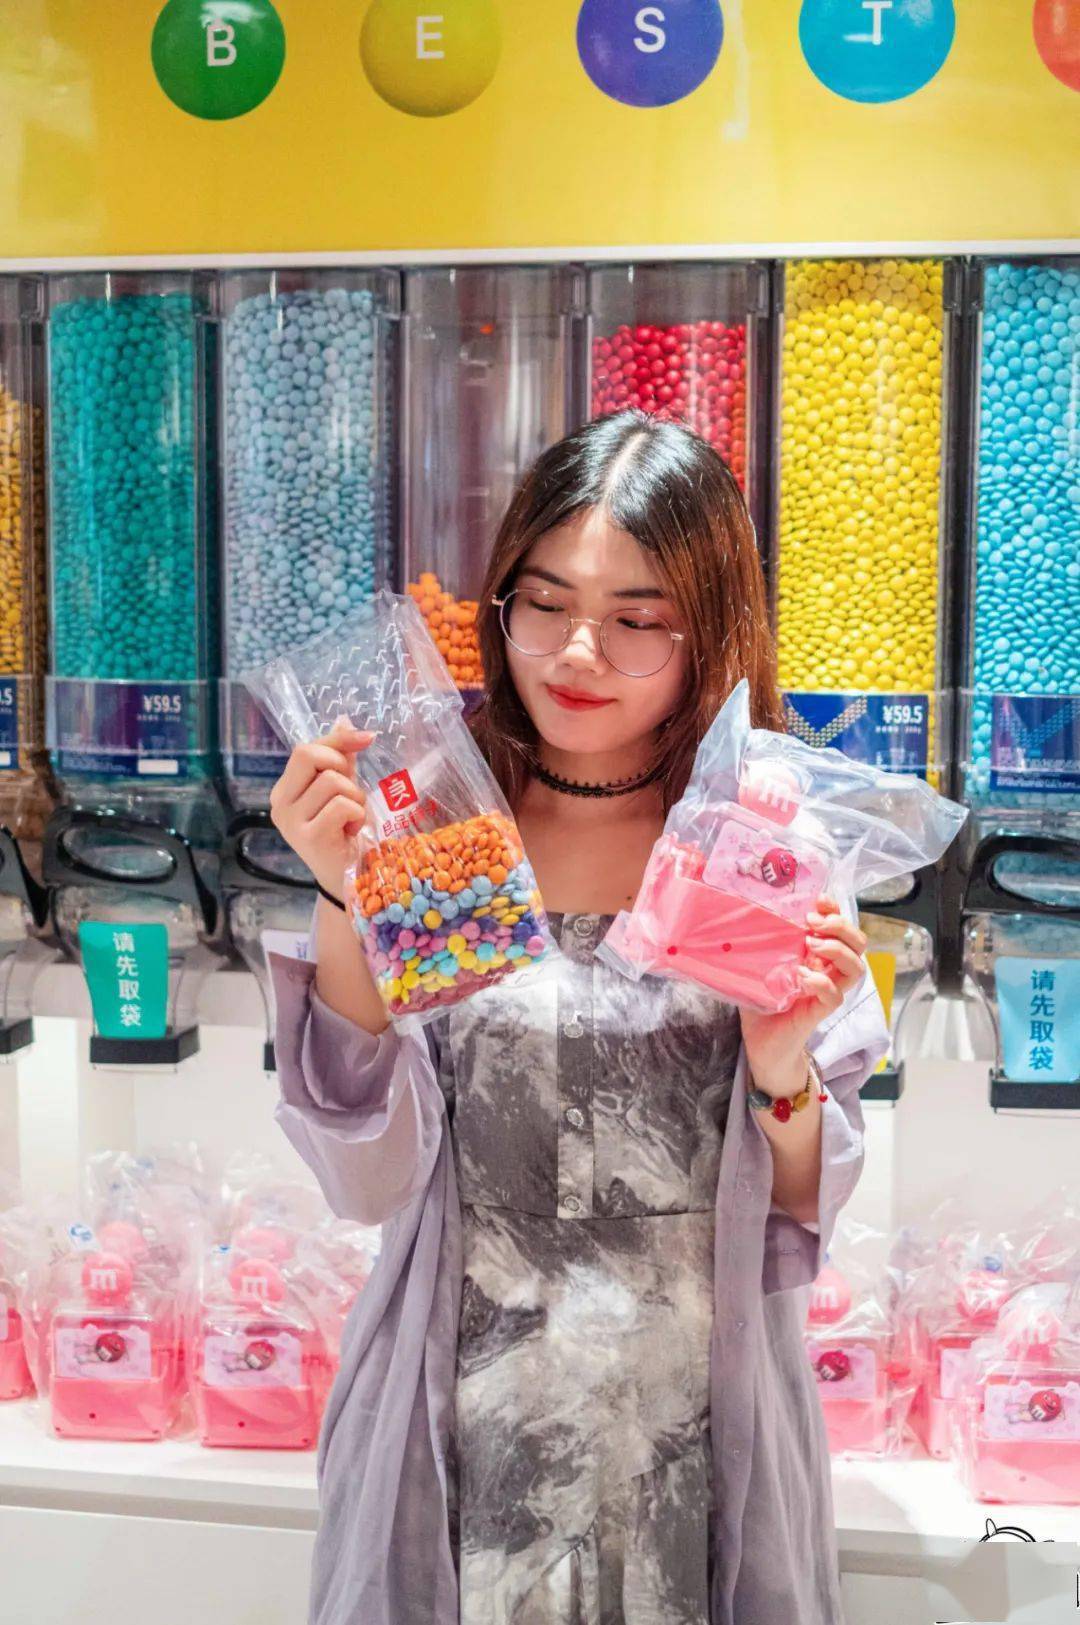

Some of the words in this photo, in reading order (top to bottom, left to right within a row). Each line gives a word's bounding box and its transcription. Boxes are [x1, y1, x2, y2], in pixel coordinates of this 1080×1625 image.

[882, 704, 923, 724] ¥59.5
[112, 931, 143, 1027] 请先取袋
[1028, 968, 1057, 1071] 请先取袋
